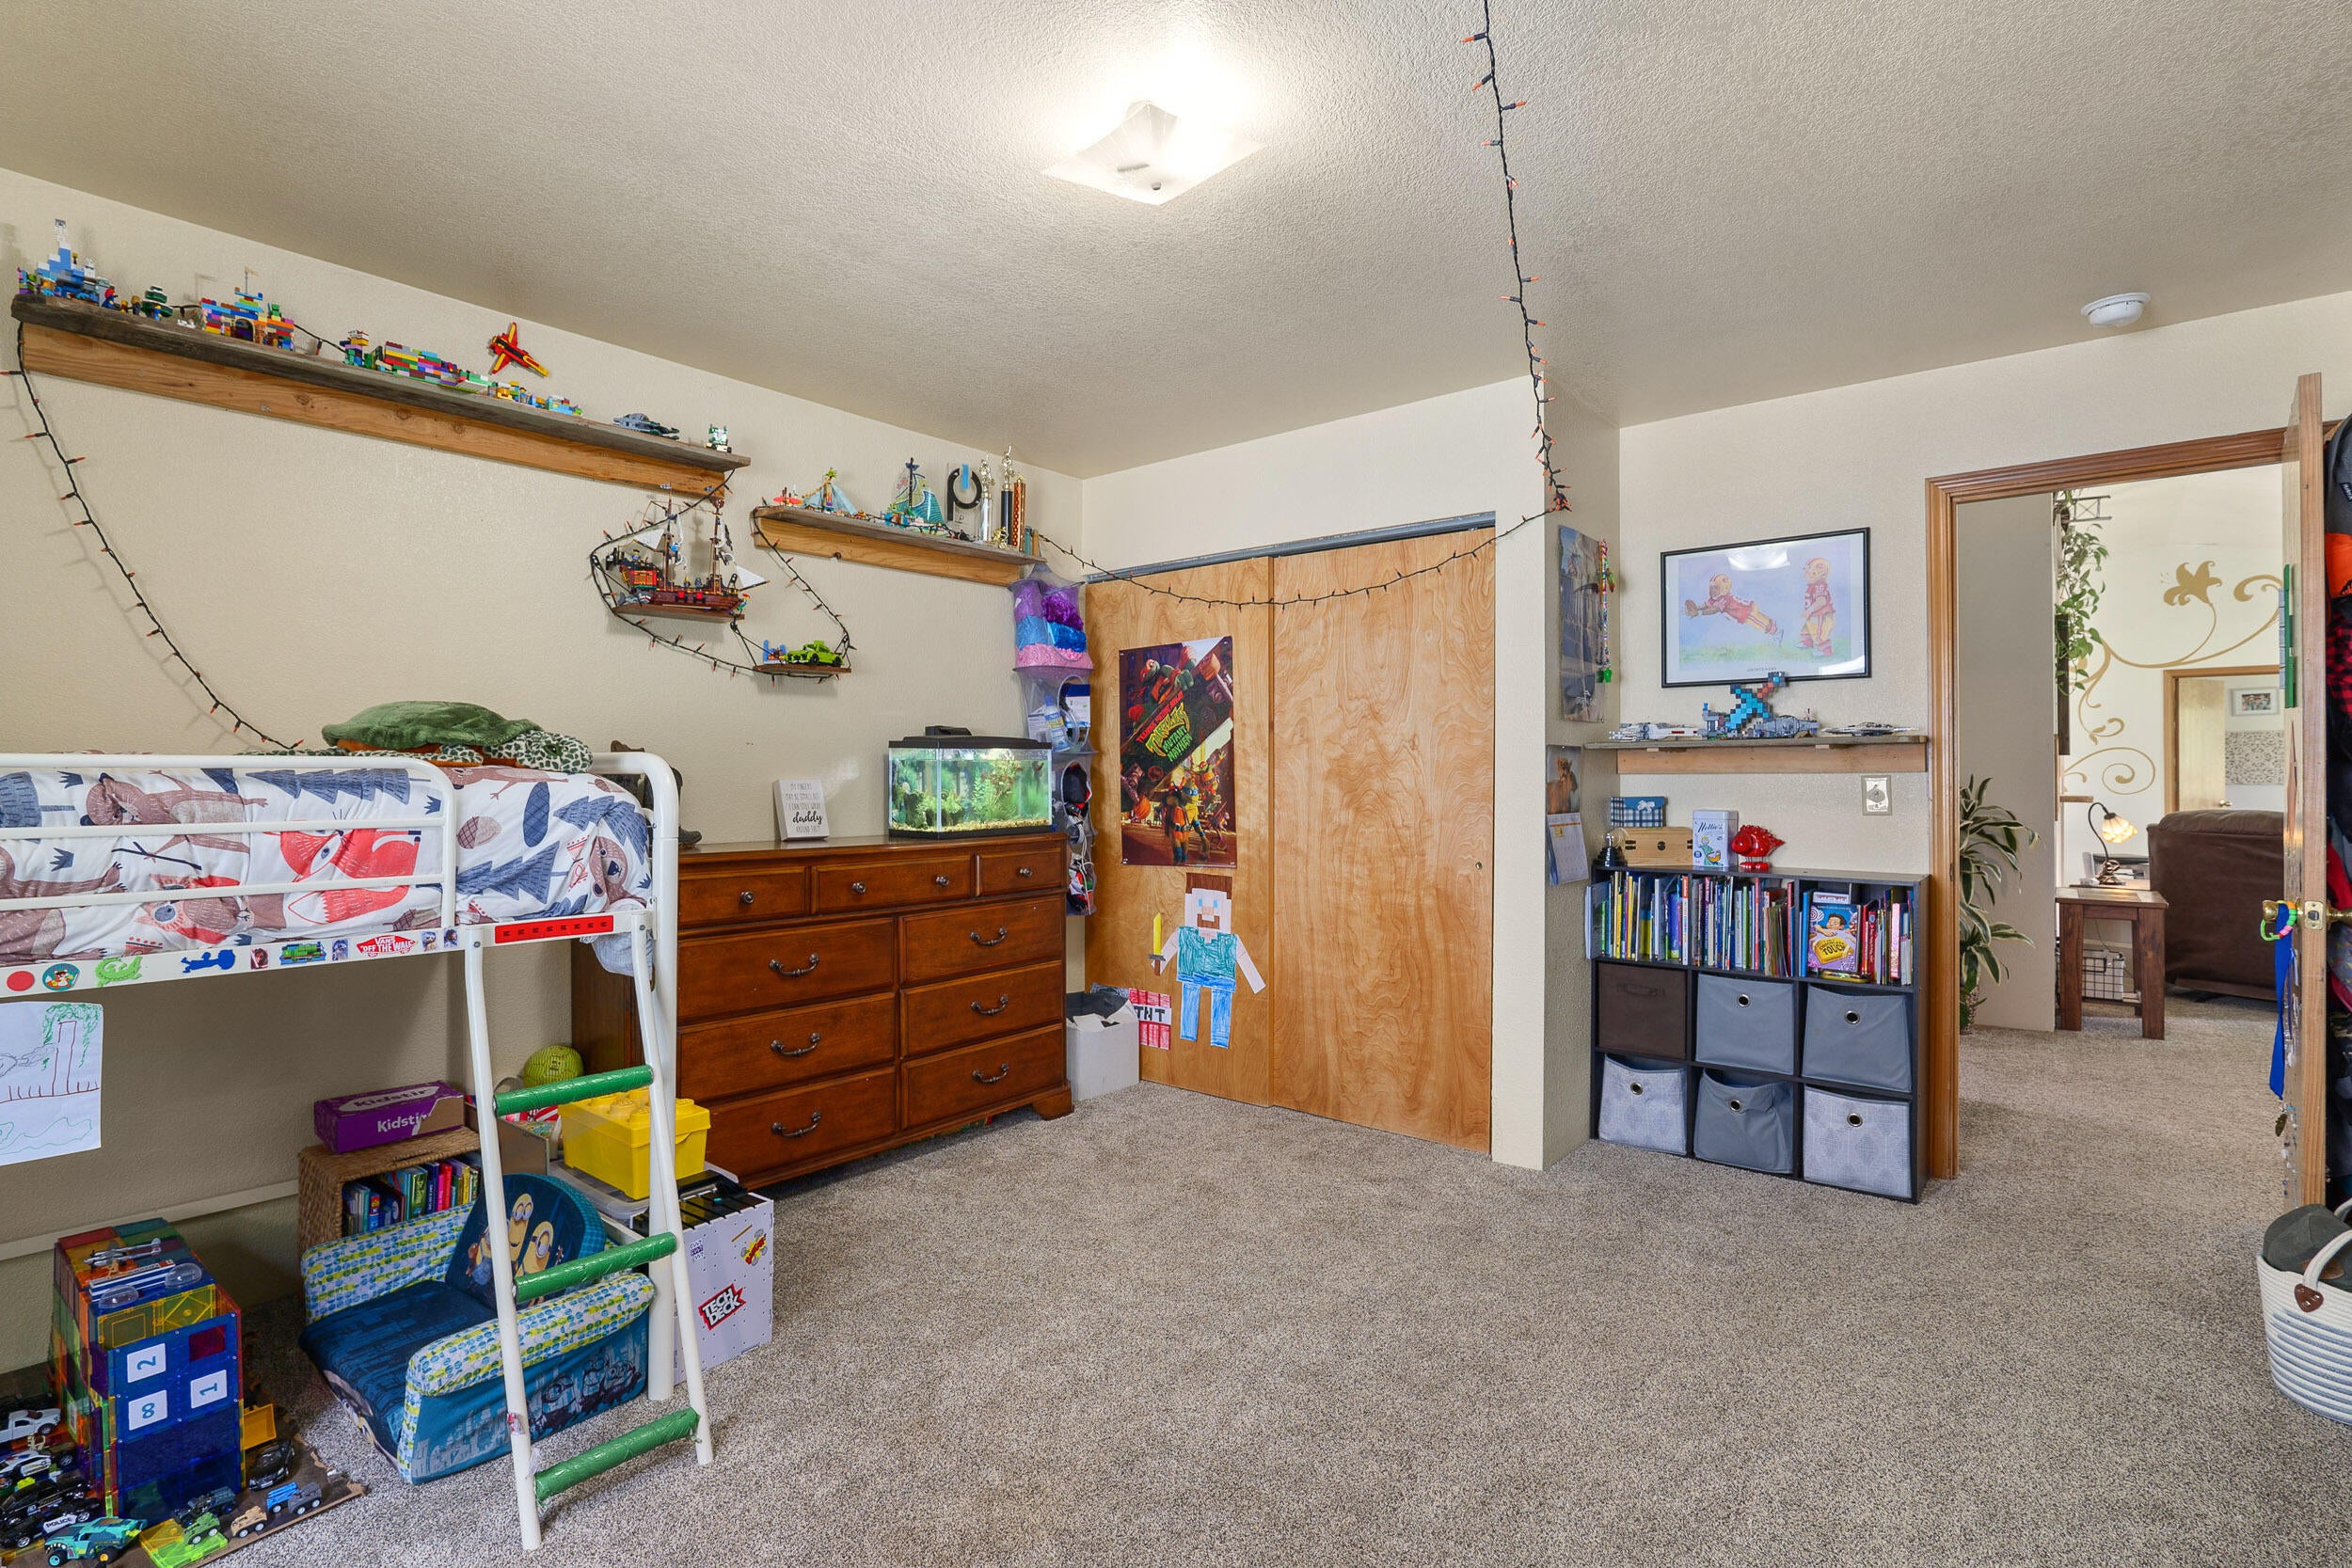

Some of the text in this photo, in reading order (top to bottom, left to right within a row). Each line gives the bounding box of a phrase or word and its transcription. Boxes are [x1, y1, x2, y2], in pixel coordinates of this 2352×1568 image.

[1145, 702, 1190, 757] TURTLES
[1162, 725, 1187, 752] MUTANT
[1168, 733, 1192, 762] MAYHEM
[792, 810, 822, 825] daddy
[377, 942, 393, 953] THE
[1822, 943, 1846, 955] TOUCH
[1134, 1006, 1166, 1022] TNT
[354, 1089, 427, 1106] Kidstir
[702, 1288, 734, 1315] TECH
[707, 1295, 741, 1326] DECK
[136, 1355, 156, 1370] 2
[141, 1402, 155, 1419] 8
[45, 1517, 72, 1528] POLICE
